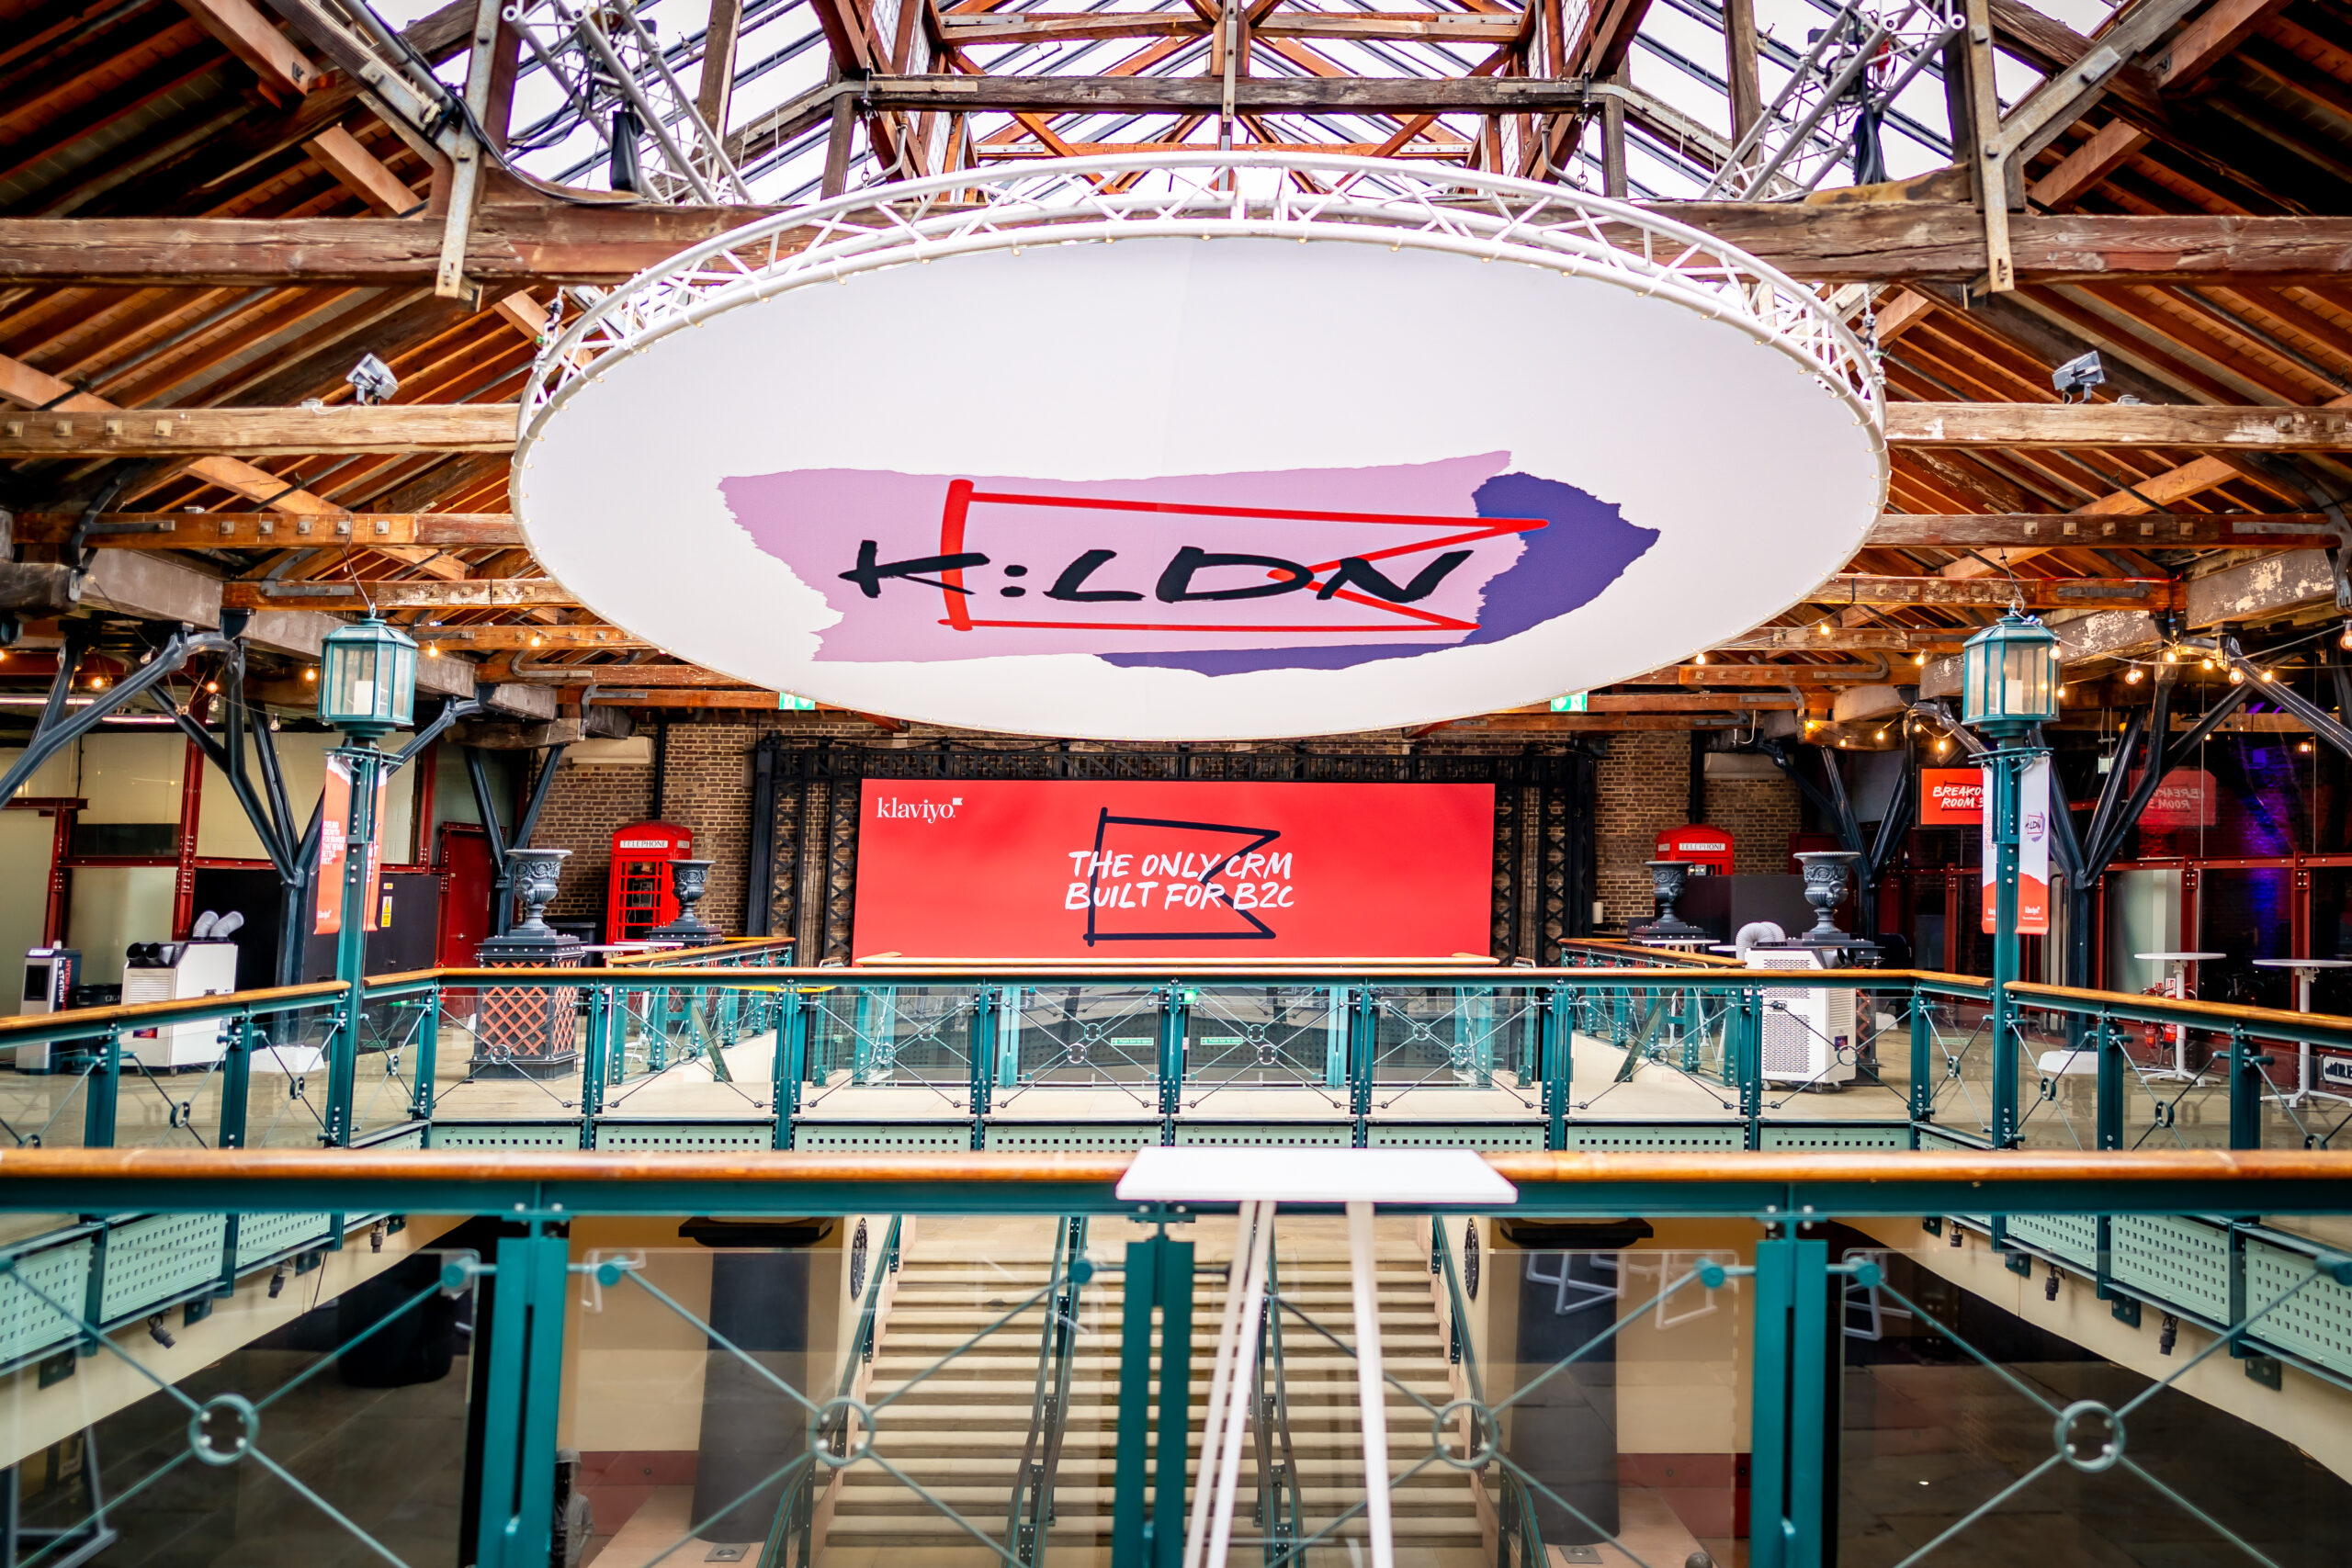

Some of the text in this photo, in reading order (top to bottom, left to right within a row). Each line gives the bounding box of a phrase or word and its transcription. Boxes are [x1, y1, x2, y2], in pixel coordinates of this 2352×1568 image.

[838, 539, 1474, 603] K:LDN
[1933, 786, 1984, 797] BREAKO
[1941, 797, 1974, 808] ROOM
[876, 797, 956, 824] klaviyo
[1069, 850, 1293, 882] THE ONLY CRM
[1065, 882, 1295, 910] BUILT FOR B2C
